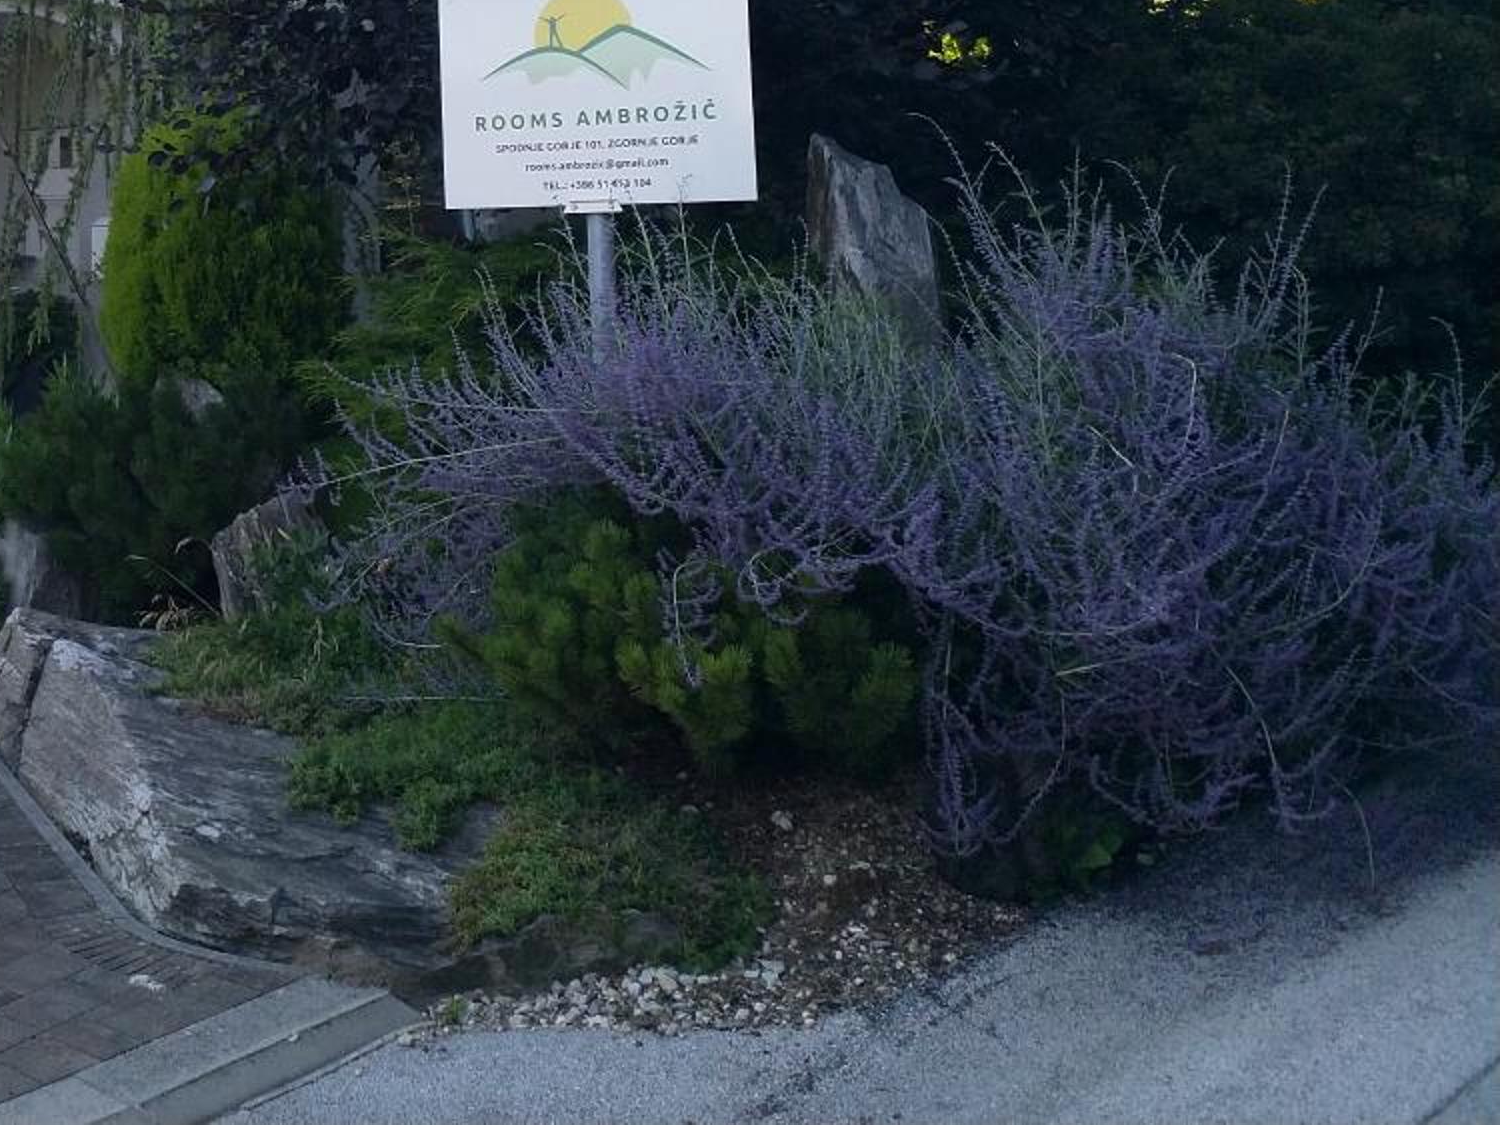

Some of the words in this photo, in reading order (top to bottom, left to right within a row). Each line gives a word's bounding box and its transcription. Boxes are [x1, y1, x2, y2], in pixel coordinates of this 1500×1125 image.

[475, 112, 563, 131] ROOMS
[576, 98, 717, 126] AMBROŽIČ
[495, 142, 545, 154] SPODNJE
[546, 140, 581, 152] GORJE
[607, 136, 658, 148] ZGORNJE
[661, 134, 699, 146] GORJE
